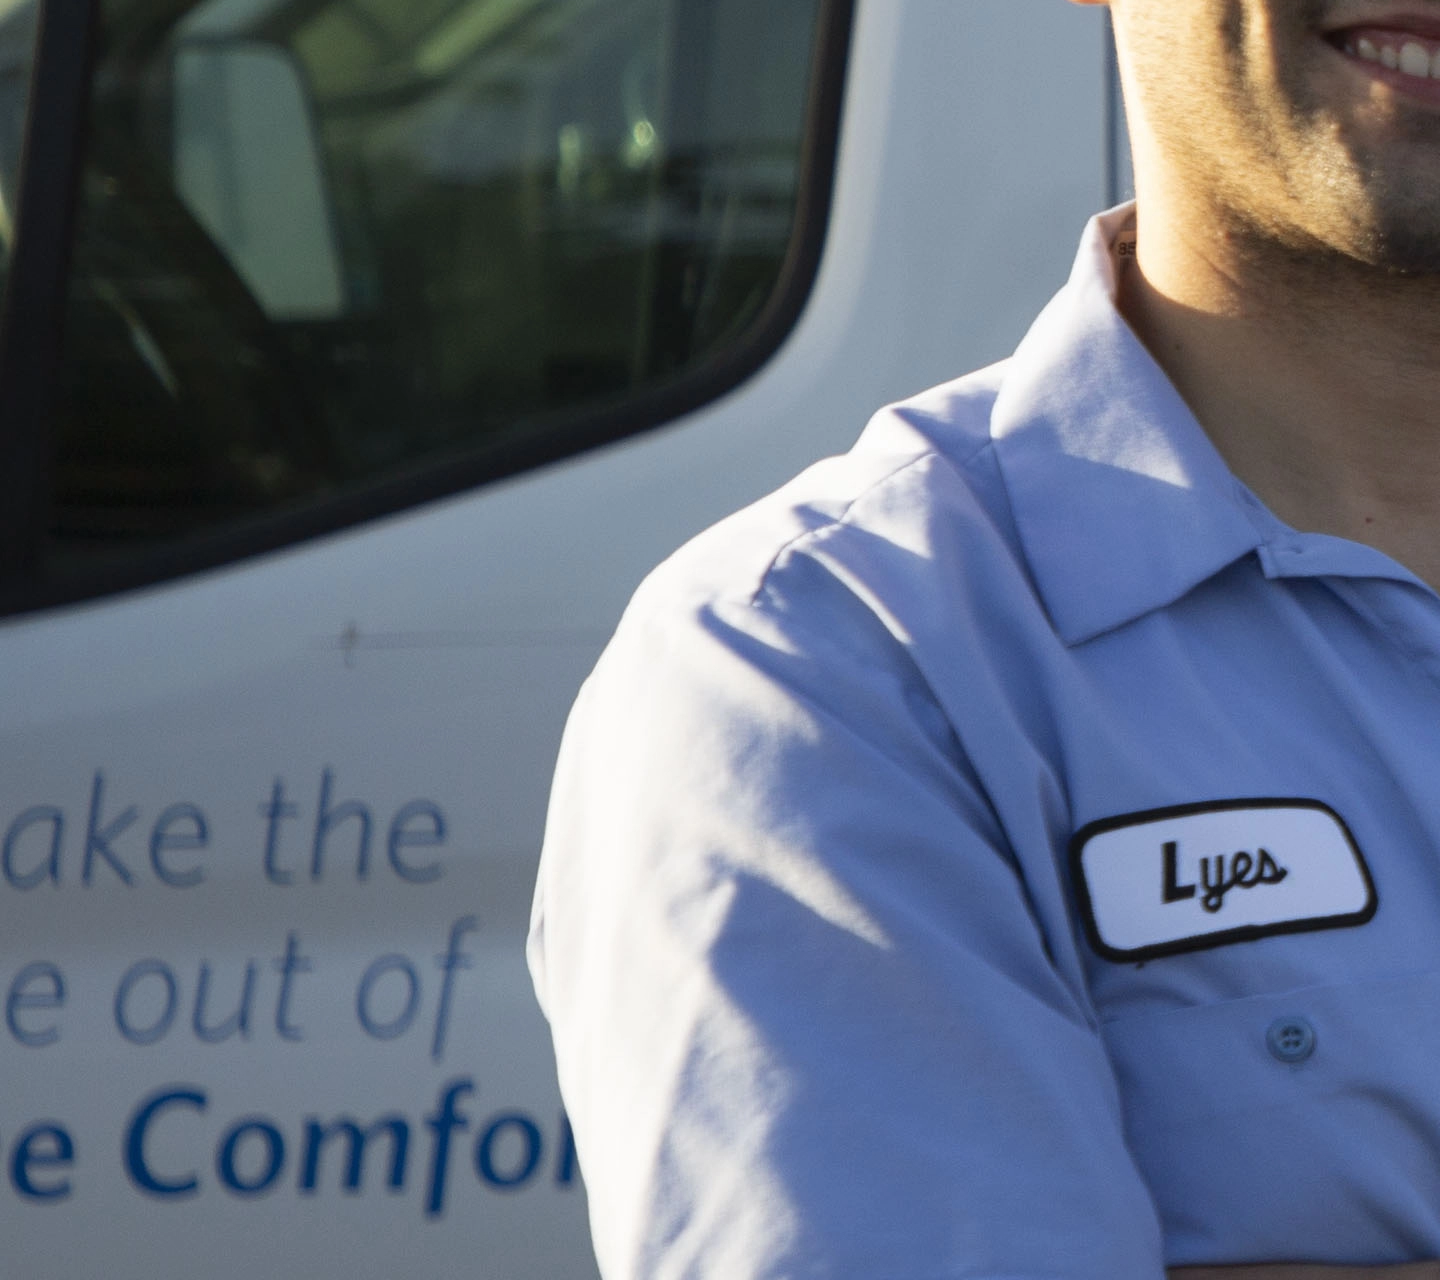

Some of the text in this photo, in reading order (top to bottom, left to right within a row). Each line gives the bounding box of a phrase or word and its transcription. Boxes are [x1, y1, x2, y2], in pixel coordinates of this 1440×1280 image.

[259, 762, 450, 888] the
[1160, 839, 1289, 914] Lyes
[111, 932, 312, 1048] out
[354, 914, 480, 1066] of
